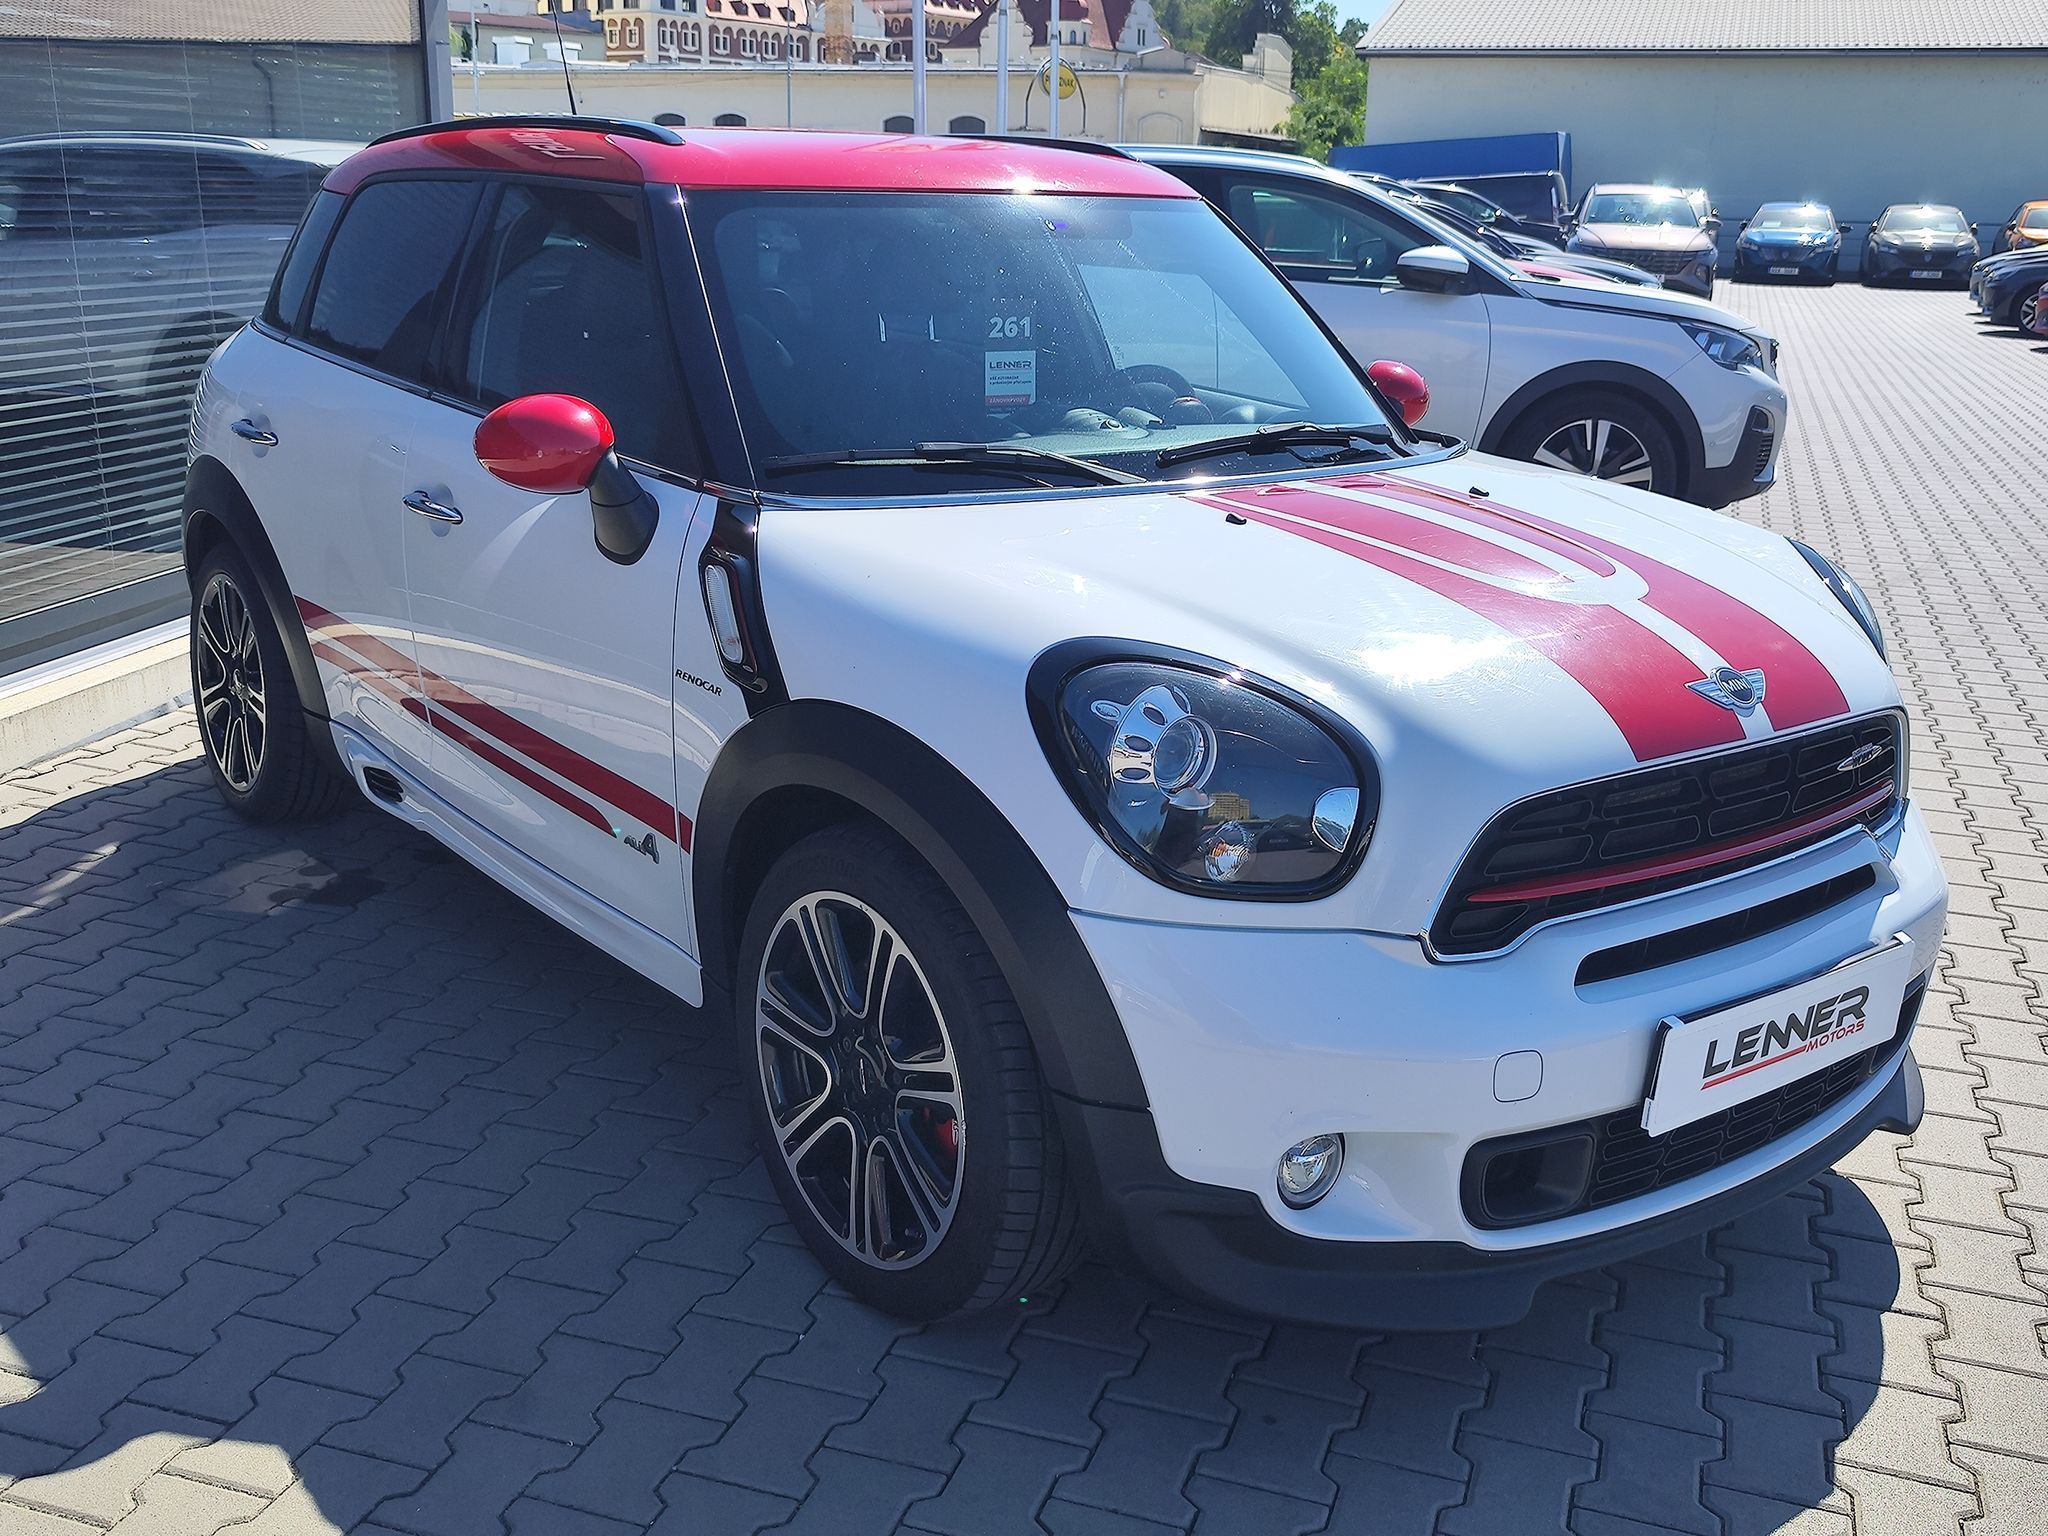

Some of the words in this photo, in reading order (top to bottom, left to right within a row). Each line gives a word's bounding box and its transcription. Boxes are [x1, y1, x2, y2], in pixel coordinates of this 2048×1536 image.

[989, 316, 1030, 338] 261
[989, 360, 1032, 369] LENNER
[675, 668, 722, 697] RENOCAR
[1703, 985, 1870, 1079] LENNER
[1806, 1019, 1865, 1053] MOTORS
